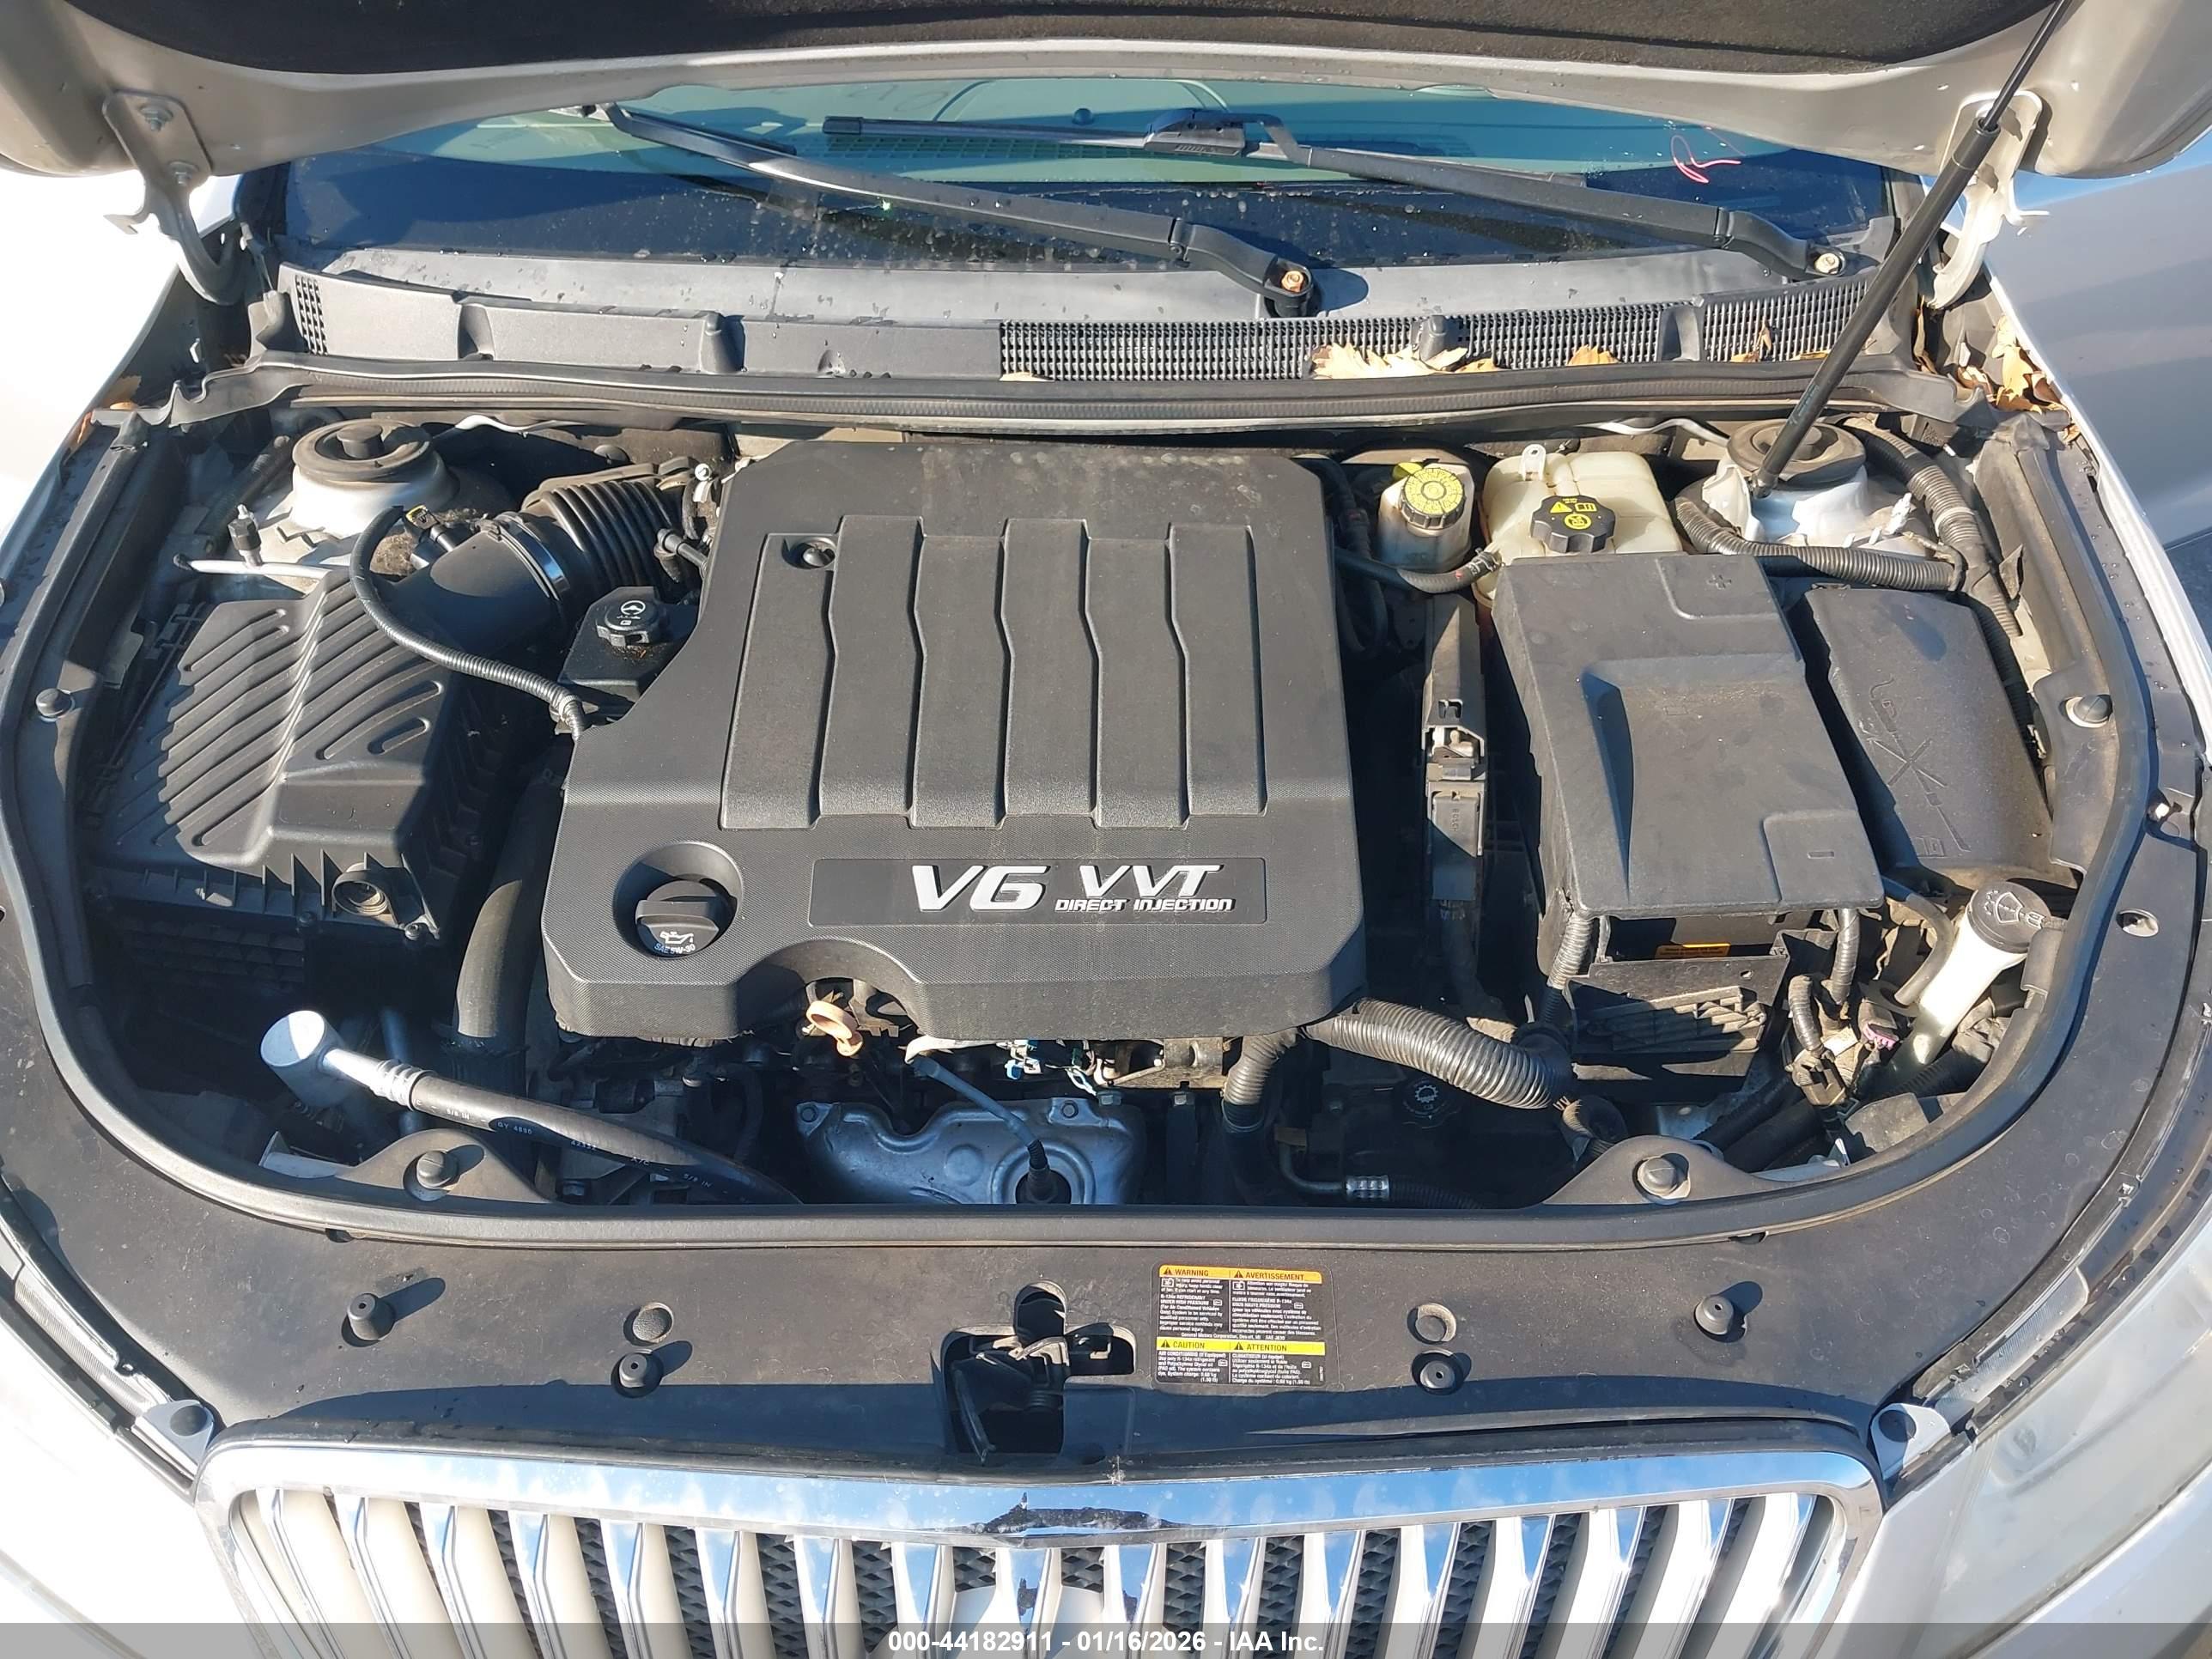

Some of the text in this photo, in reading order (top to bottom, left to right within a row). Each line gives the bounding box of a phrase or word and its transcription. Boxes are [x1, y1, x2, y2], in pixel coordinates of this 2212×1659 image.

[912, 865, 1224, 912] V6 VVT
[1054, 898, 1235, 912] DIRECT INJECTION
[654, 943, 696, 954] SAE 5W-30
